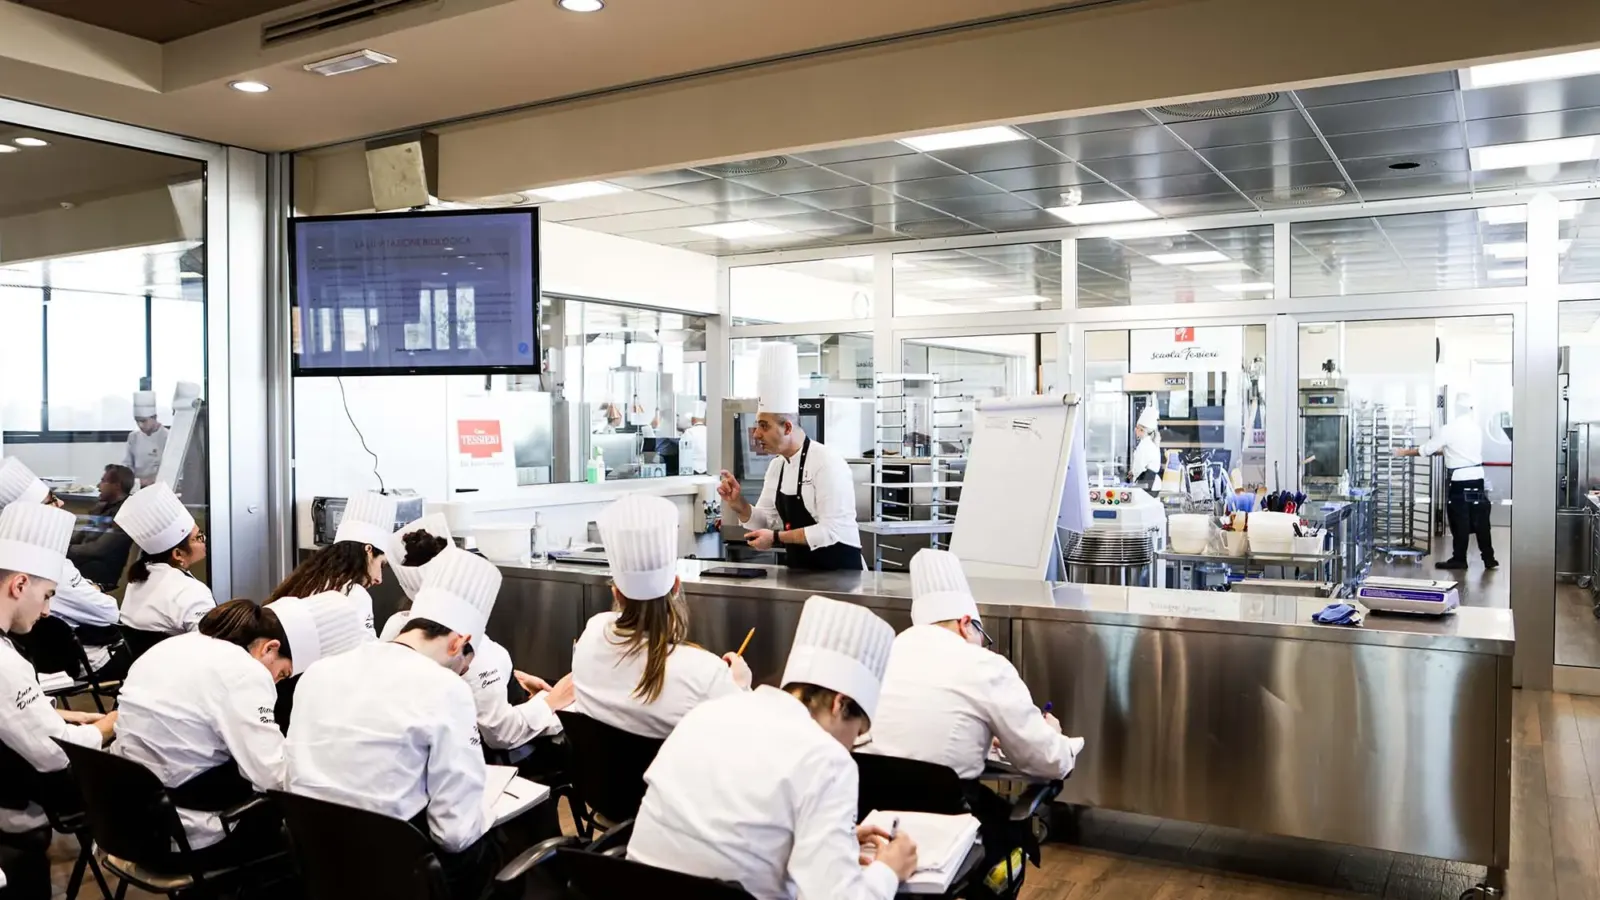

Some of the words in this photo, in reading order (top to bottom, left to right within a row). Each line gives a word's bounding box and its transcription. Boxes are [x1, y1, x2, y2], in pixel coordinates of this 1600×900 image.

[1150, 350, 1180, 360] scuola
[1180, 346, 1219, 360] Tessieri
[460, 434, 500, 446] TESSIERI
